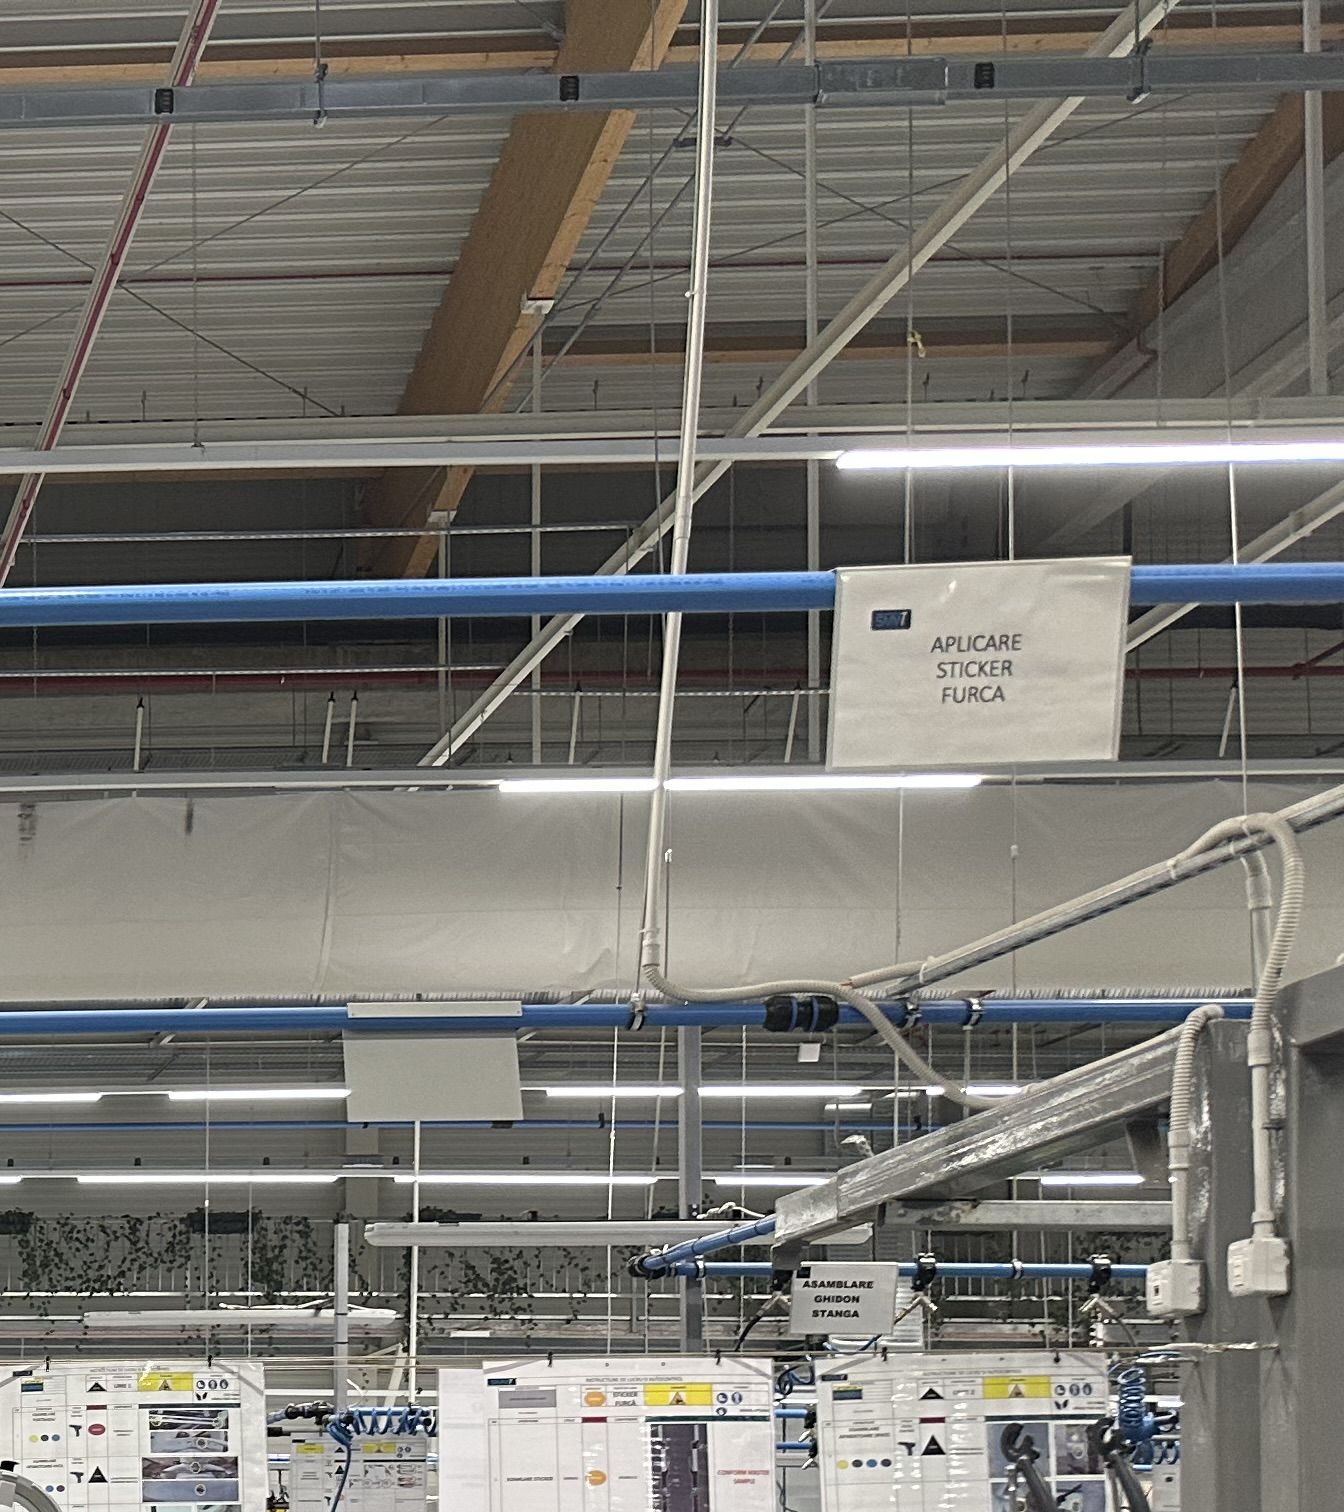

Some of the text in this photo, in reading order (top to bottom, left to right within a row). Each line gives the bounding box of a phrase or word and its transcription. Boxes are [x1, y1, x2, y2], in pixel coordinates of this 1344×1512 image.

[930, 633, 1023, 654] APLICARE
[936, 660, 1014, 680] STICKER
[941, 685, 1006, 704] FURCA
[802, 1280, 874, 1289] ASAMBLARE
[814, 1295, 861, 1303] GHIDON
[812, 1310, 859, 1318] STANGA
